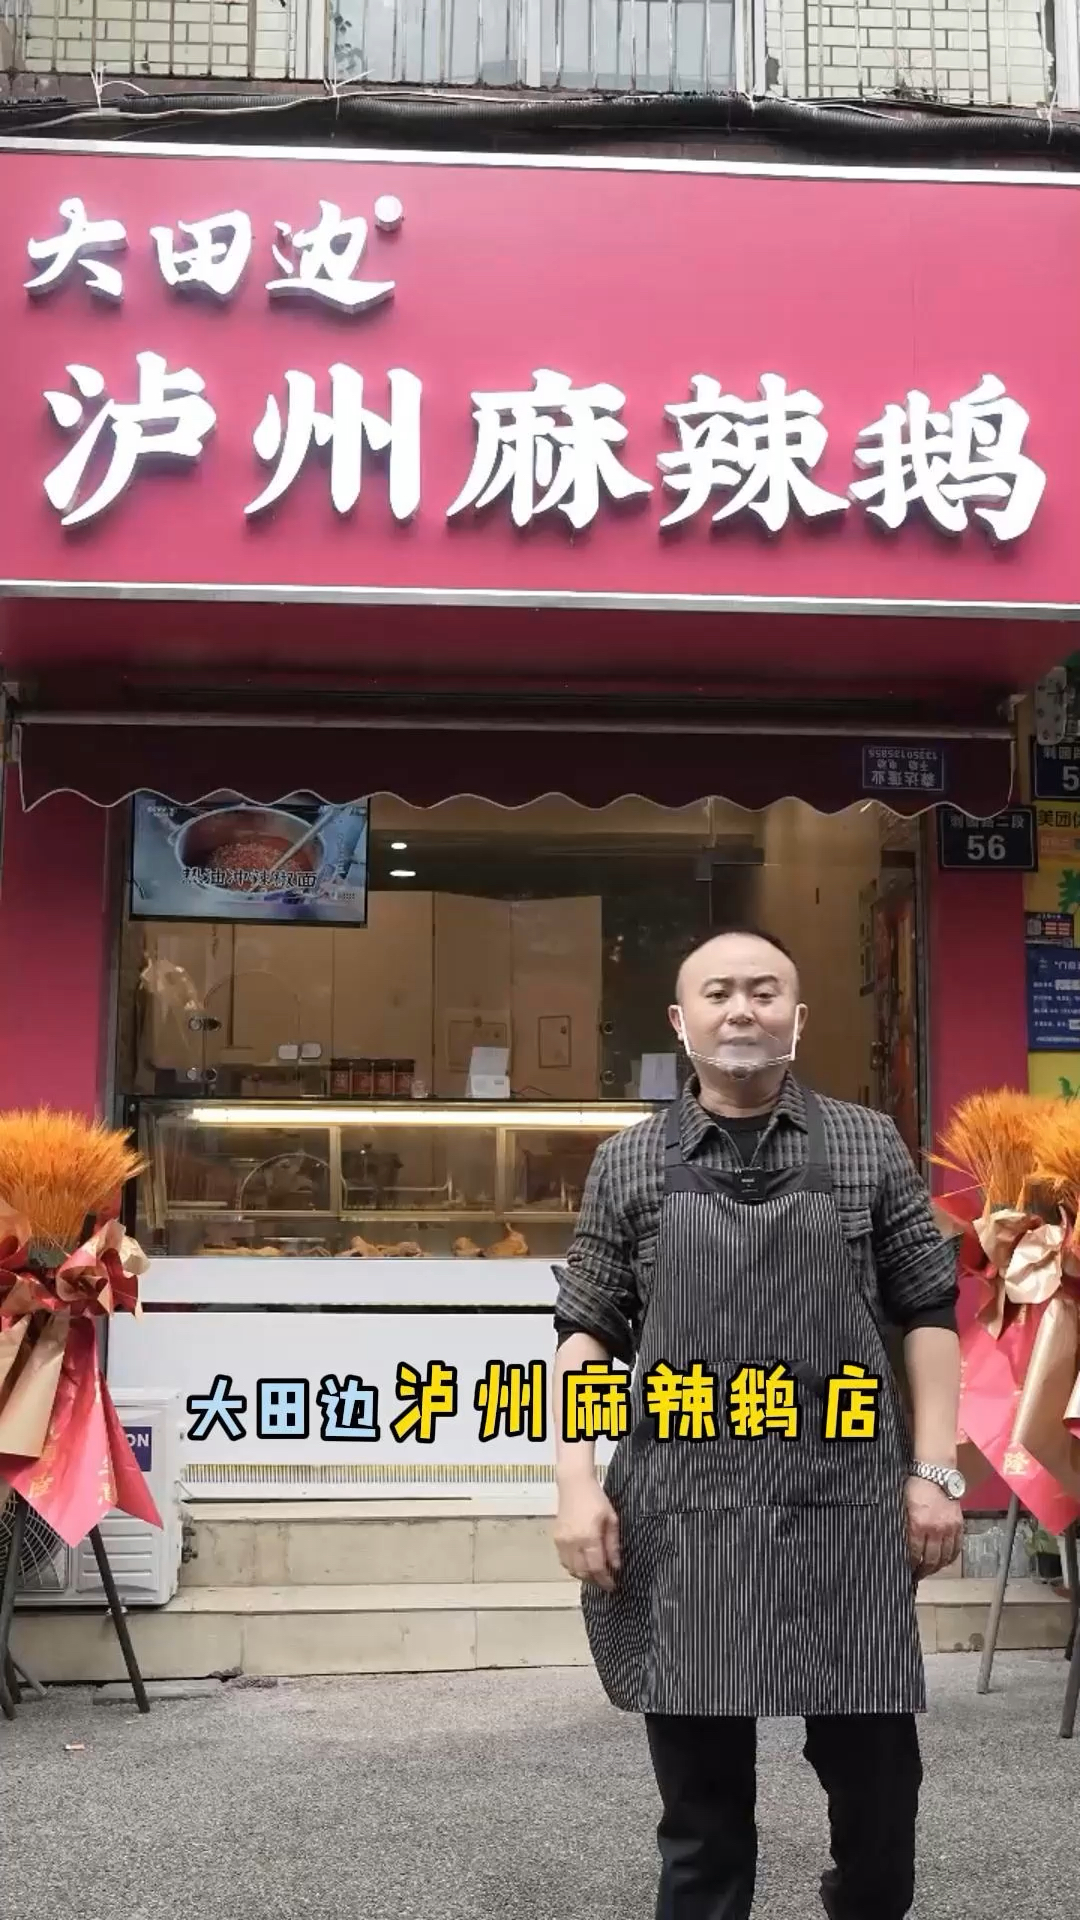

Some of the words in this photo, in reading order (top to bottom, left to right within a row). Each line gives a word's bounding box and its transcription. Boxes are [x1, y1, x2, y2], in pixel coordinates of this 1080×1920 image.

[24, 195, 399, 312] 大田边
[42, 351, 1048, 543] 泸州麻辣鹅
[967, 835, 1006, 860] 56
